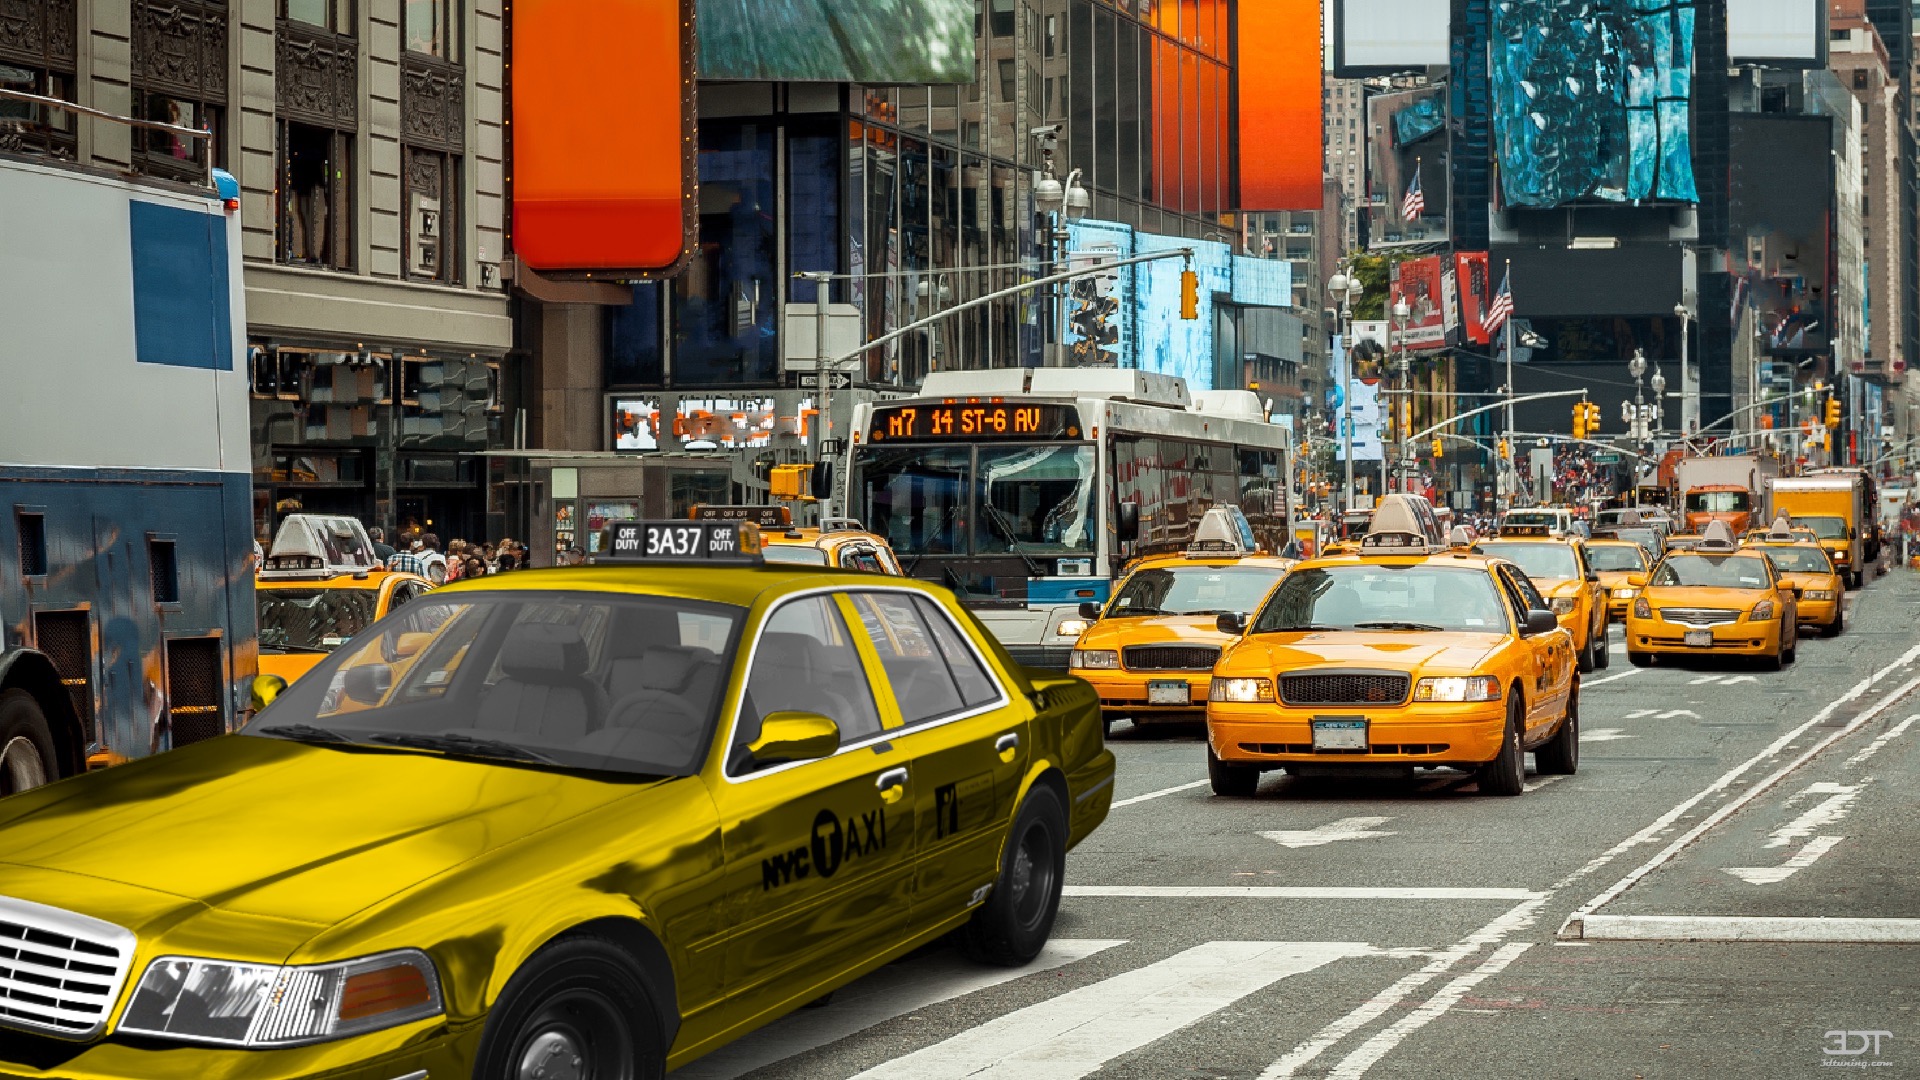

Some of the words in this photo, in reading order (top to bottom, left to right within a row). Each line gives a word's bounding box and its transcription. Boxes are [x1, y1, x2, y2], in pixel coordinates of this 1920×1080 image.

[932, 409, 953, 434] 14
[962, 408, 1006, 433] ST-6
[1015, 408, 1040, 432] AV
[615, 539, 639, 550] DUTY
[709, 540, 735, 551] DUTY
[619, 528, 636, 539] OFF
[646, 528, 702, 555] 3A37
[713, 529, 732, 540] OFF
[762, 846, 810, 891] NYC
